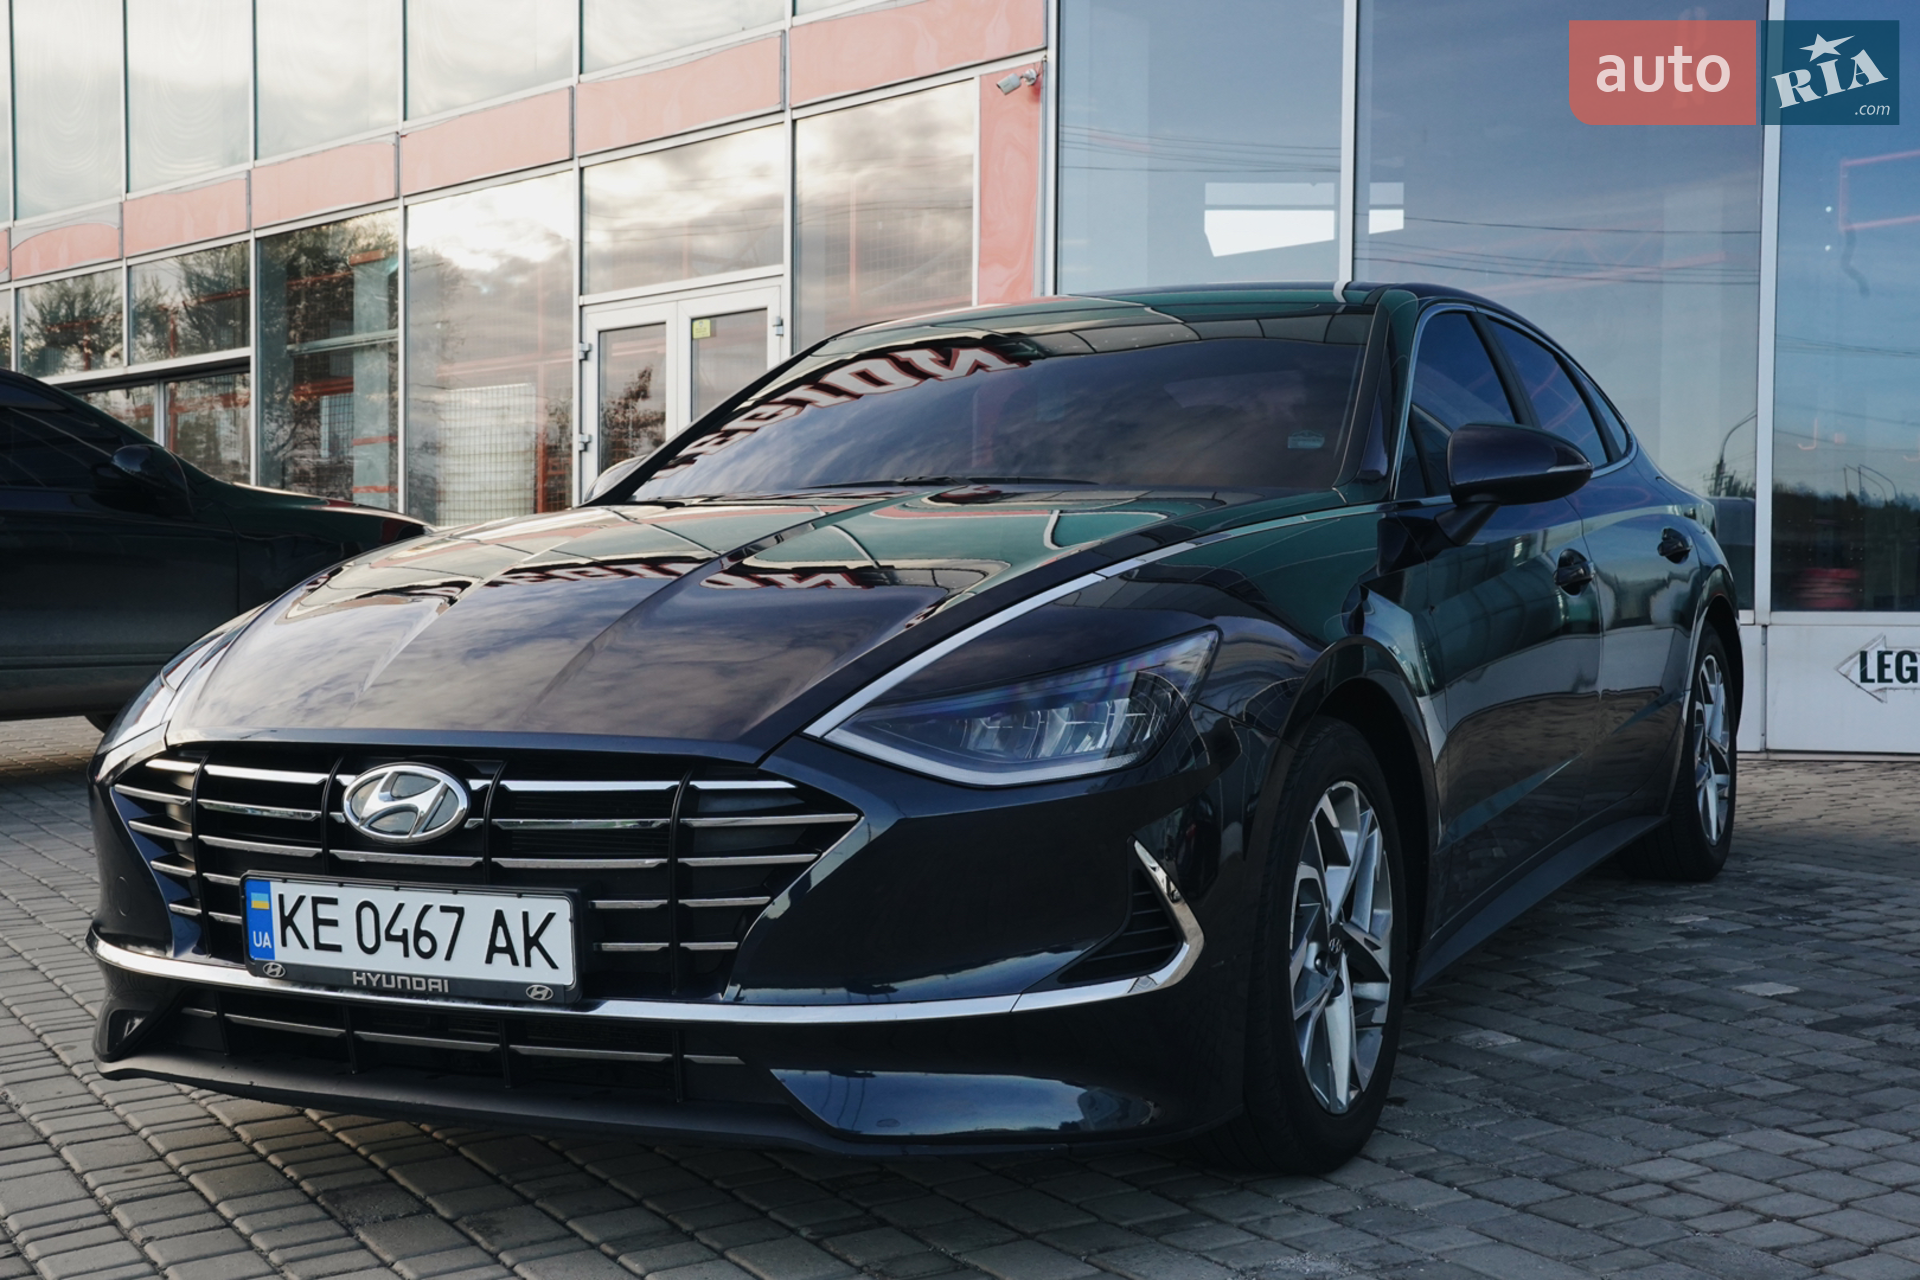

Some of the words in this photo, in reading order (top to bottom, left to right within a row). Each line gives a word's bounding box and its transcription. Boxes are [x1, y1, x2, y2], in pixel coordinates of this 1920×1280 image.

[1860, 650, 1919, 683] LEG
[253, 931, 272, 949] UA
[278, 893, 342, 952] KE
[355, 900, 465, 960] 0467
[485, 909, 559, 969] AK
[352, 971, 449, 993] HYUNDAI
